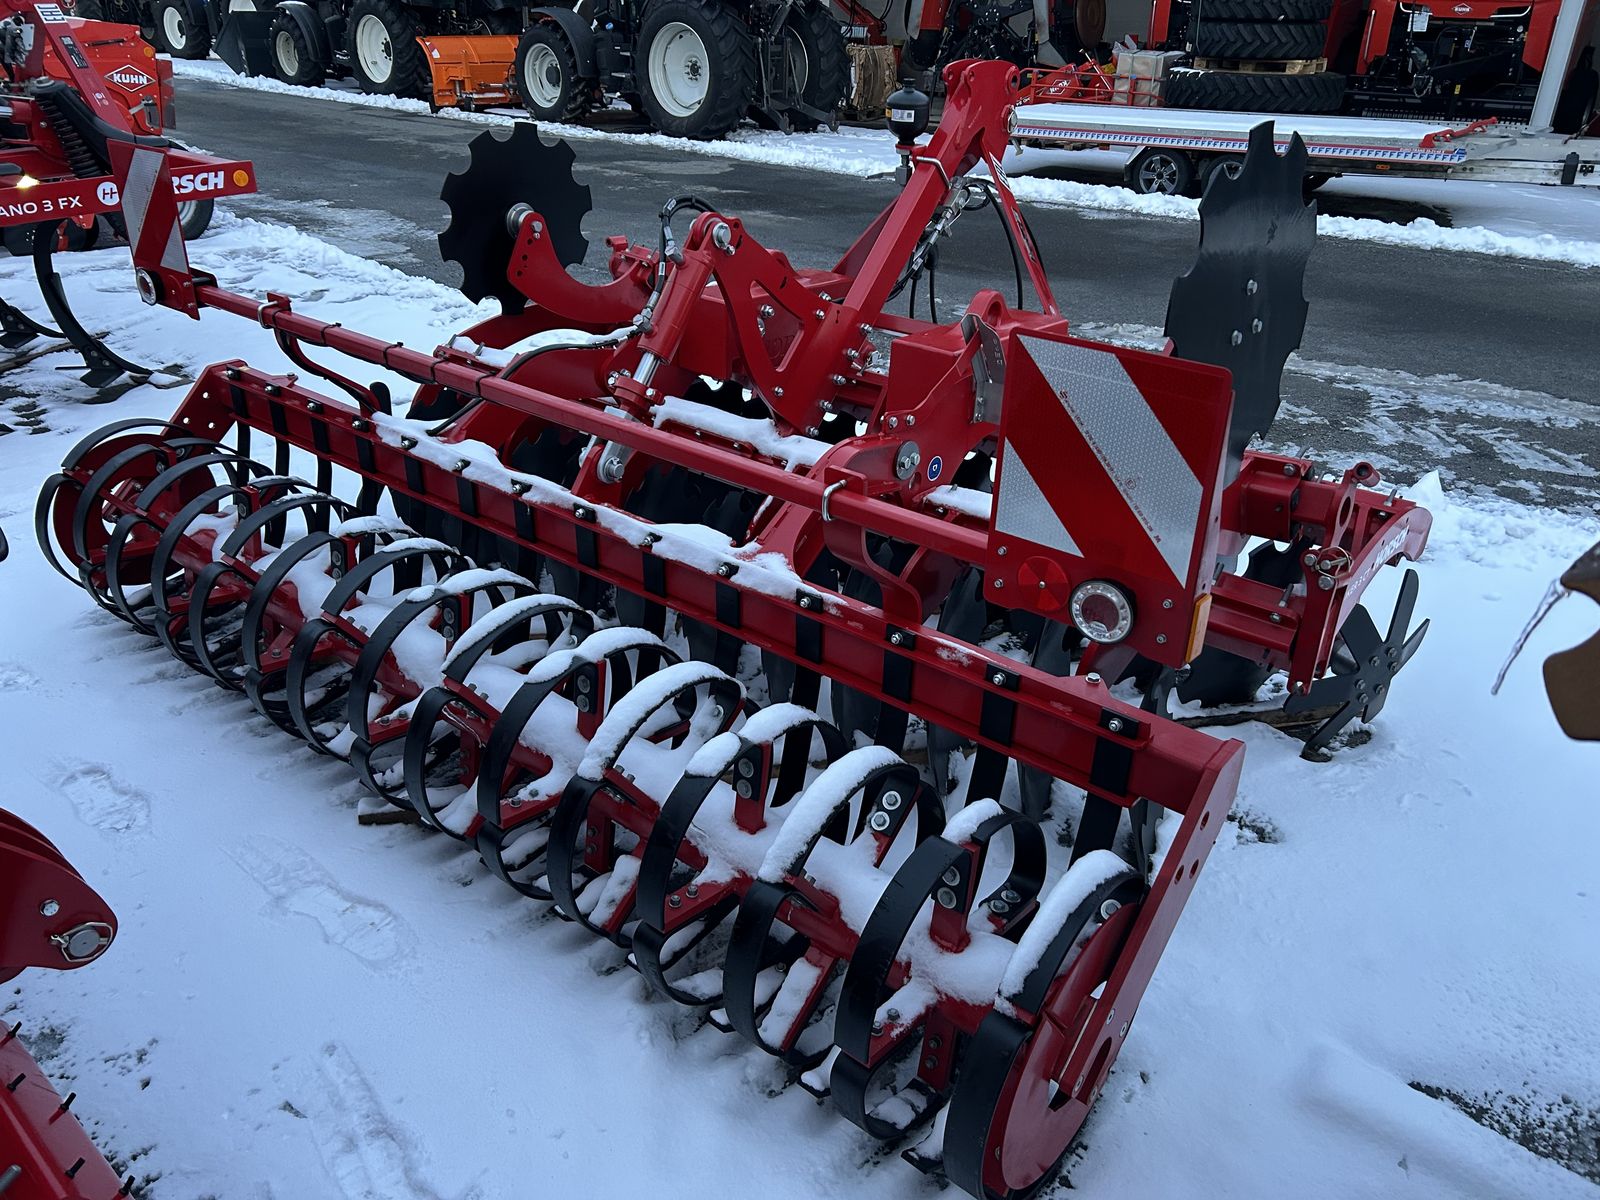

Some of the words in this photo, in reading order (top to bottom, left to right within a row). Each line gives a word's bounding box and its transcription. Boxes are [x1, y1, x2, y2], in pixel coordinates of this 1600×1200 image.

[113, 73, 148, 85] KUHN
[42, 199, 54, 212] 3
[58, 195, 83, 210] FX
